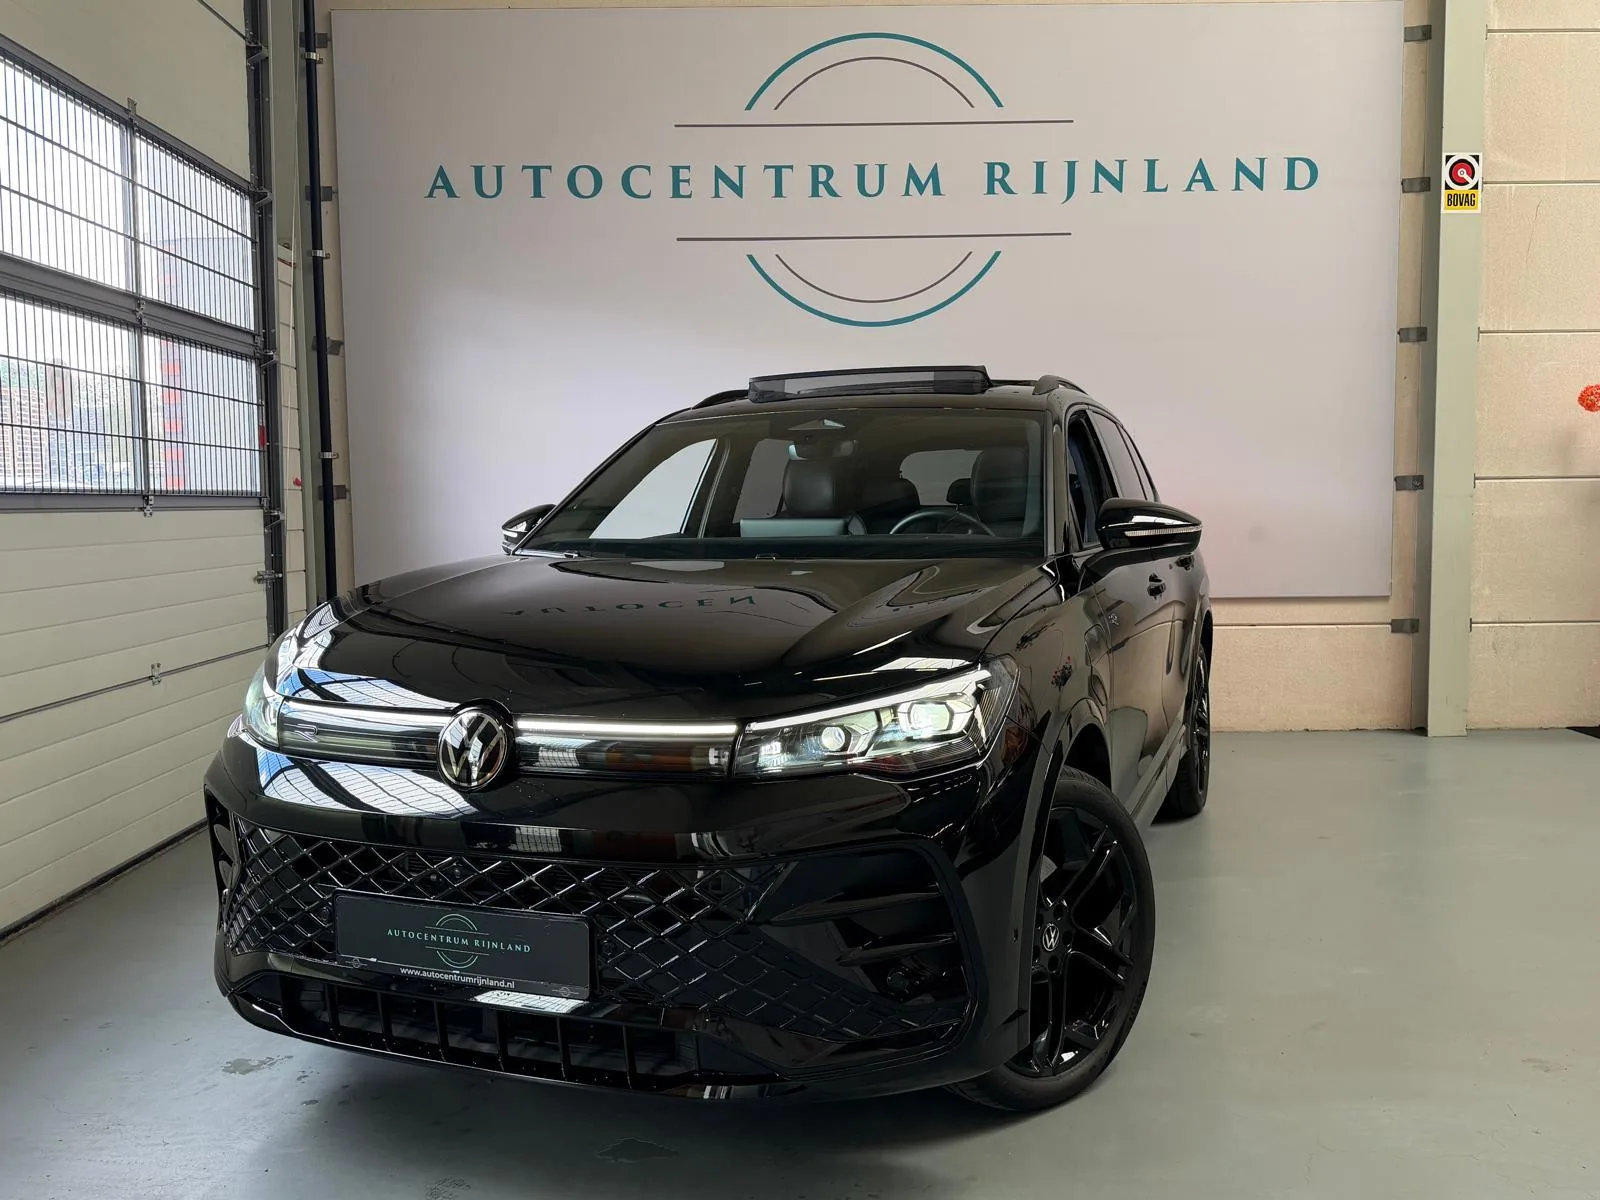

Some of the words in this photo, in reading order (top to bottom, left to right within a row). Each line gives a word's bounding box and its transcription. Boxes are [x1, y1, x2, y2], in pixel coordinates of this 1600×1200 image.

[423, 162, 945, 199] AUTOCENTRUM
[983, 156, 1319, 204] RIJNLAND
[1447, 193, 1476, 207] BOVAG
[387, 928, 470, 946] AUTOCENTRUM
[474, 939, 531, 953] RIJNLAND
[400, 967, 515, 989] www.autocentrumrijnland.nl
